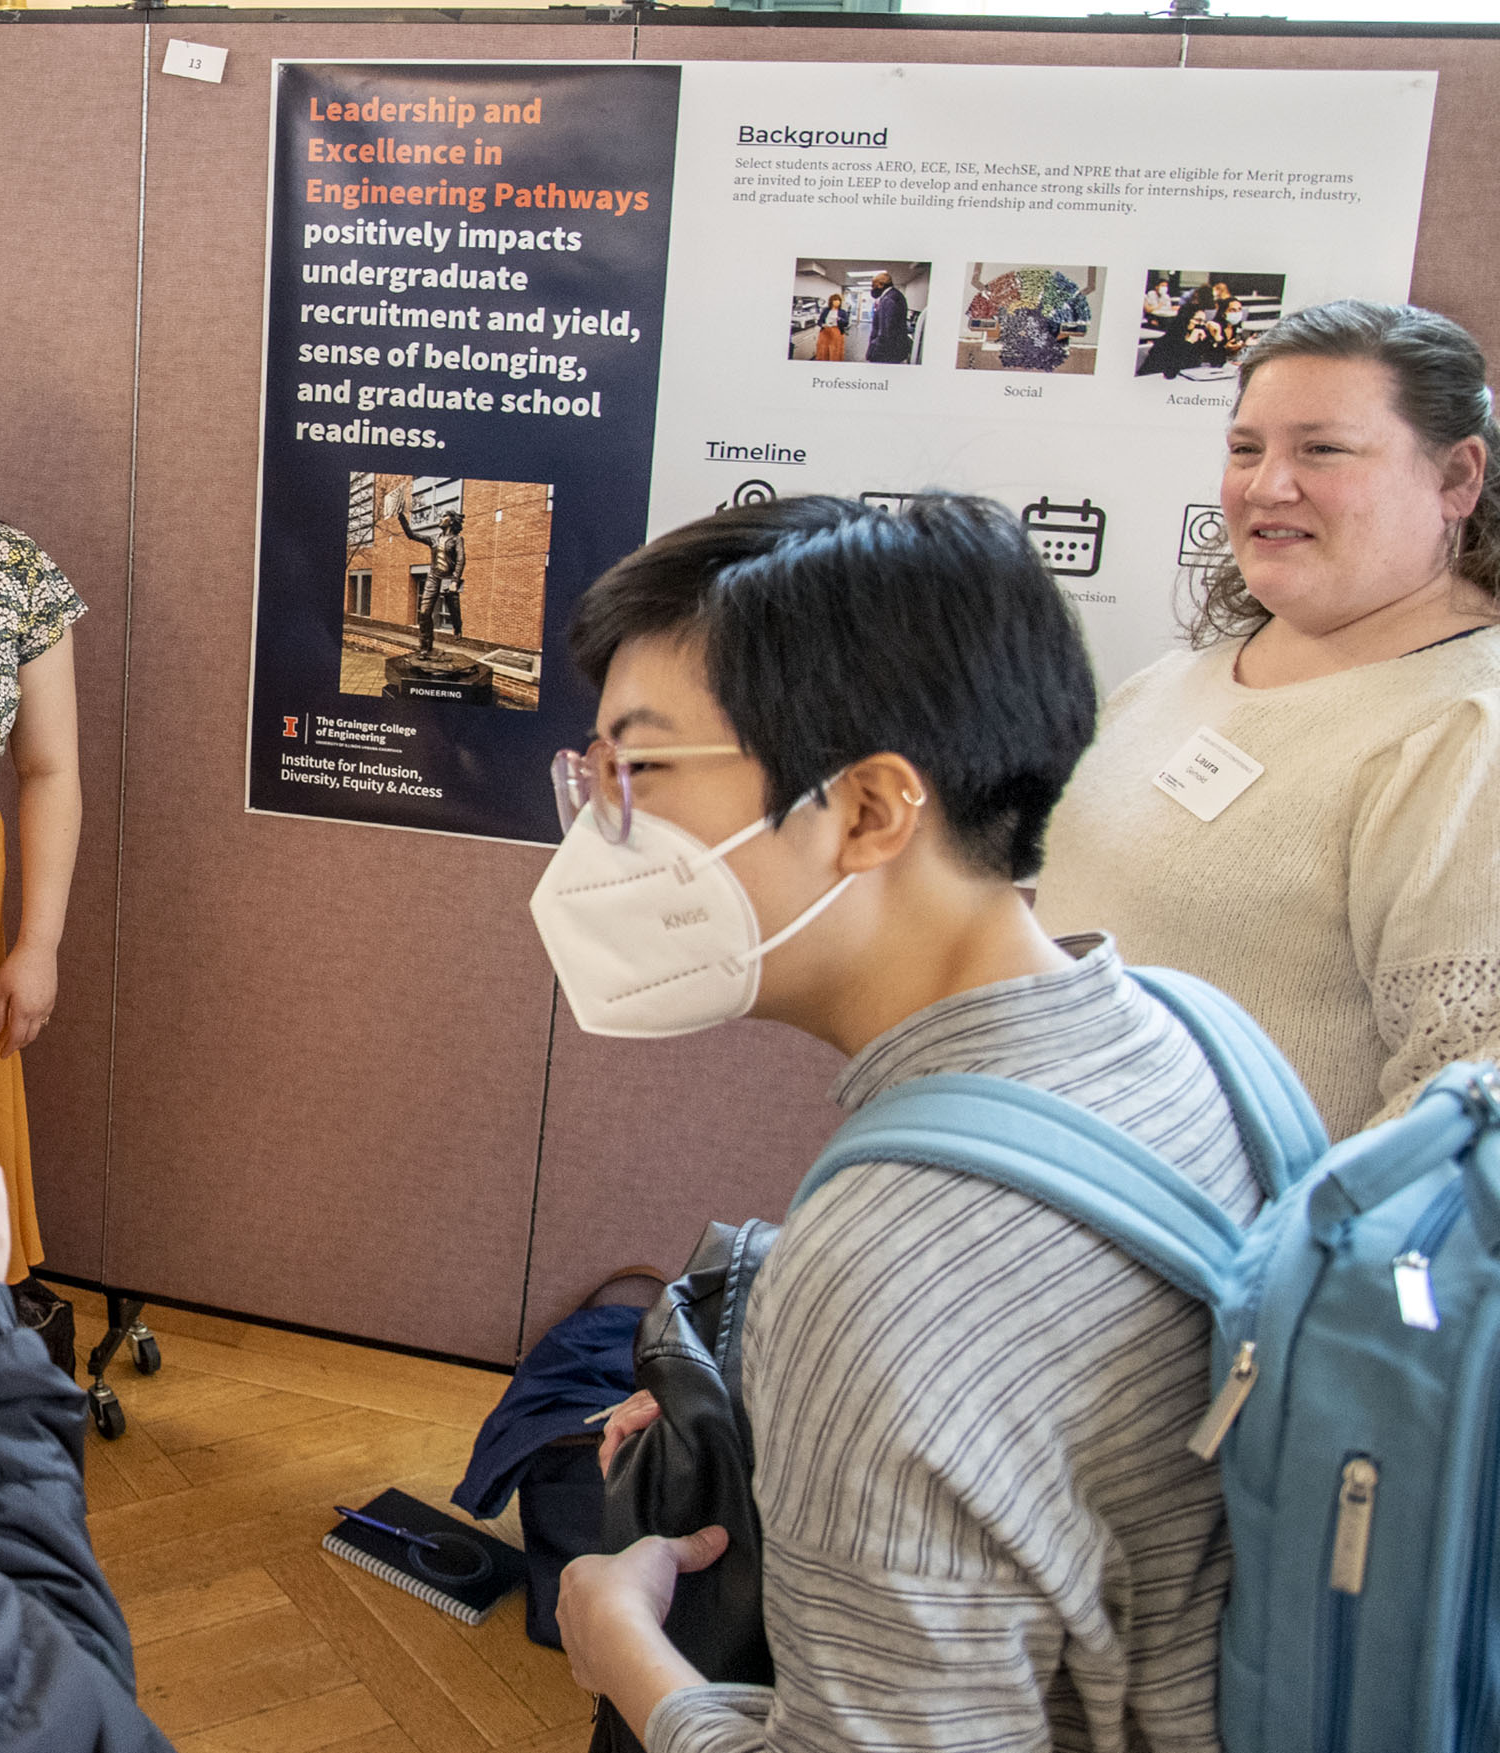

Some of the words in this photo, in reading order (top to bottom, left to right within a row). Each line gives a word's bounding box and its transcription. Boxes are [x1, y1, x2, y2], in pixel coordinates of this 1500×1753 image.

[188, 58, 202, 70] 13
[310, 95, 475, 128] Leadership
[484, 96, 541, 124] and
[308, 136, 466, 164] Excellence
[474, 138, 501, 164] in
[738, 126, 889, 148] Background
[735, 157, 772, 168] Select
[776, 158, 828, 170] students
[832, 162, 872, 170] across
[876, 160, 916, 173] AERO,
[921, 162, 950, 174] ECE,
[956, 162, 979, 174] ISE,
[984, 163, 1040, 176] MechSE,
[1044, 164, 1069, 176] and
[1073, 165, 1111, 177] NPRE
[1115, 166, 1140, 178] that
[1144, 170, 1166, 179] are
[1169, 167, 1219, 182] eligible
[1223, 168, 1243, 180] for
[1247, 169, 1283, 181] Merit
[1287, 173, 1353, 185] programs
[306, 176, 486, 212] Engineering
[495, 183, 648, 216] Pathways
[734, 176, 754, 186] are
[758, 174, 800, 187] invited
[804, 177, 816, 186] to
[818, 176, 842, 190] join
[848, 177, 881, 188] LEEP
[884, 179, 896, 188] to
[900, 178, 950, 193] develop
[954, 180, 978, 191] and
[981, 180, 1037, 192] enhance
[1041, 183, 1083, 196] strong
[1086, 182, 1120, 195] skills
[1125, 183, 1144, 195] for
[1148, 185, 1227, 200] internships,
[1233, 187, 1295, 200] research,
[1300, 188, 1360, 203] industry,
[732, 190, 756, 201] and
[759, 191, 814, 204] graduate
[818, 192, 858, 204] school
[862, 193, 897, 205] while
[900, 194, 954, 209] building
[958, 195, 1025, 212] friendship
[1028, 198, 1053, 209] and
[1056, 200, 1136, 214] community.
[304, 219, 451, 252] positively
[459, 221, 581, 254] impacts
[303, 260, 528, 292] undergraduate
[301, 301, 480, 330] recruitment
[487, 307, 544, 332] and
[552, 307, 640, 343] yield,
[298, 344, 380, 365] sense
[387, 342, 418, 367] of
[424, 346, 586, 381] belonging,
[812, 377, 889, 391] Professional
[1004, 385, 1043, 398] Social
[297, 379, 350, 403] and
[357, 383, 494, 411] graduate
[500, 388, 601, 417] school
[1167, 394, 1232, 408] Academic
[296, 418, 445, 449] readiness.
[706, 441, 807, 464] Timeline
[410, 688, 462, 699] PIONEERING
[283, 716, 298, 737] I
[316, 716, 334, 729] The
[336, 718, 378, 734] Grainger
[380, 723, 416, 737] College
[316, 727, 327, 736] of
[328, 728, 386, 745] Engineering
[282, 753, 335, 770] Institute
[338, 758, 356, 772] for
[359, 762, 422, 782] Inclusion,
[1194, 753, 1219, 774] Laura
[281, 769, 339, 788] Diversity,
[342, 776, 384, 794] Equity
[386, 781, 396, 793] &
[398, 781, 442, 798] Access
[662, 908, 708, 930] KN95
